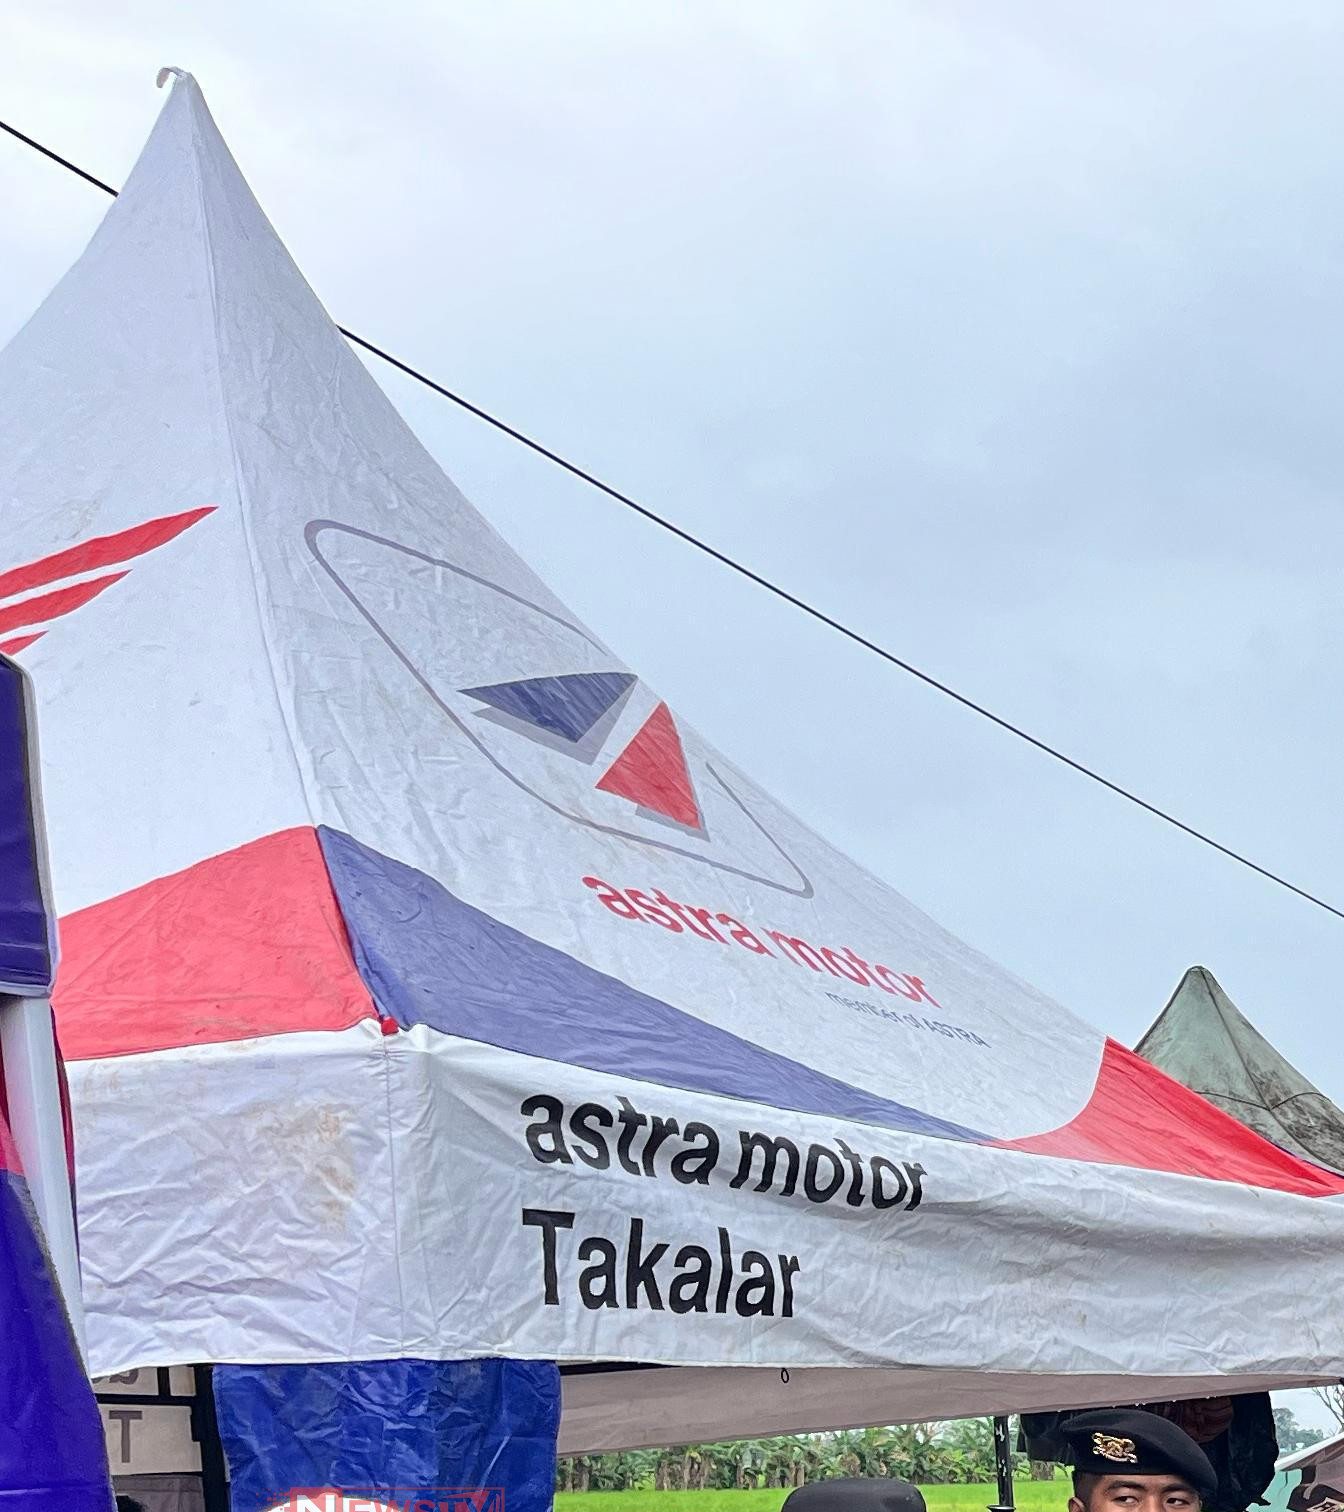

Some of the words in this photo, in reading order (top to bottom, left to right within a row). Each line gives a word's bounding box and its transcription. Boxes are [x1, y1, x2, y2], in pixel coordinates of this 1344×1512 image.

[582, 876, 777, 958] astra
[761, 926, 942, 1008] motor
[521, 1094, 721, 1185] astra
[729, 1129, 928, 1211] motor
[522, 1208, 800, 1318] Takalar
